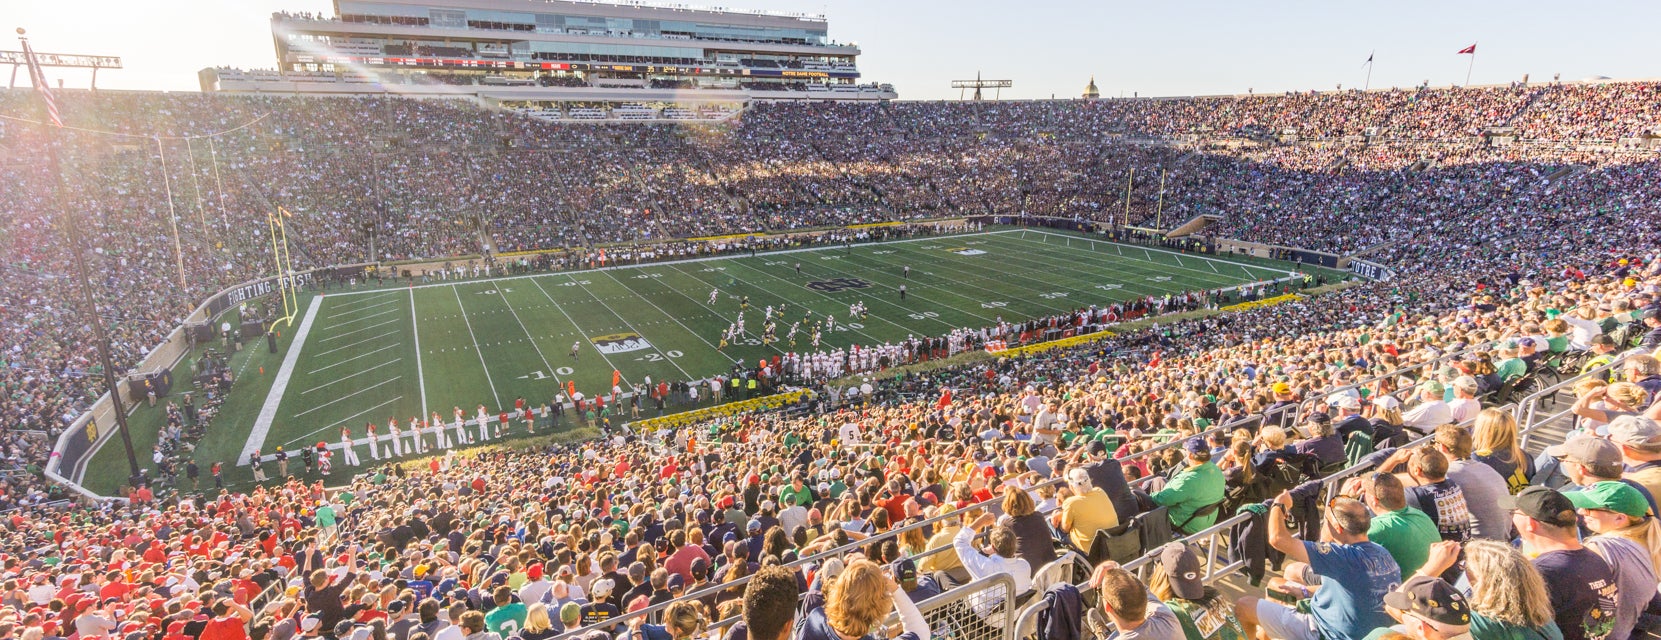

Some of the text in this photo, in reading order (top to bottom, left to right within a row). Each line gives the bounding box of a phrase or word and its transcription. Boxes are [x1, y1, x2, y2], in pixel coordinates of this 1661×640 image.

[1351, 260, 1377, 278] NOTRE
[227, 281, 272, 306] FIGHTING
[907, 311, 940, 320] 50
[835, 322, 865, 332] 40
[644, 350, 684, 362] 20
[529, 366, 575, 381] 10
[848, 430, 854, 440] 5
